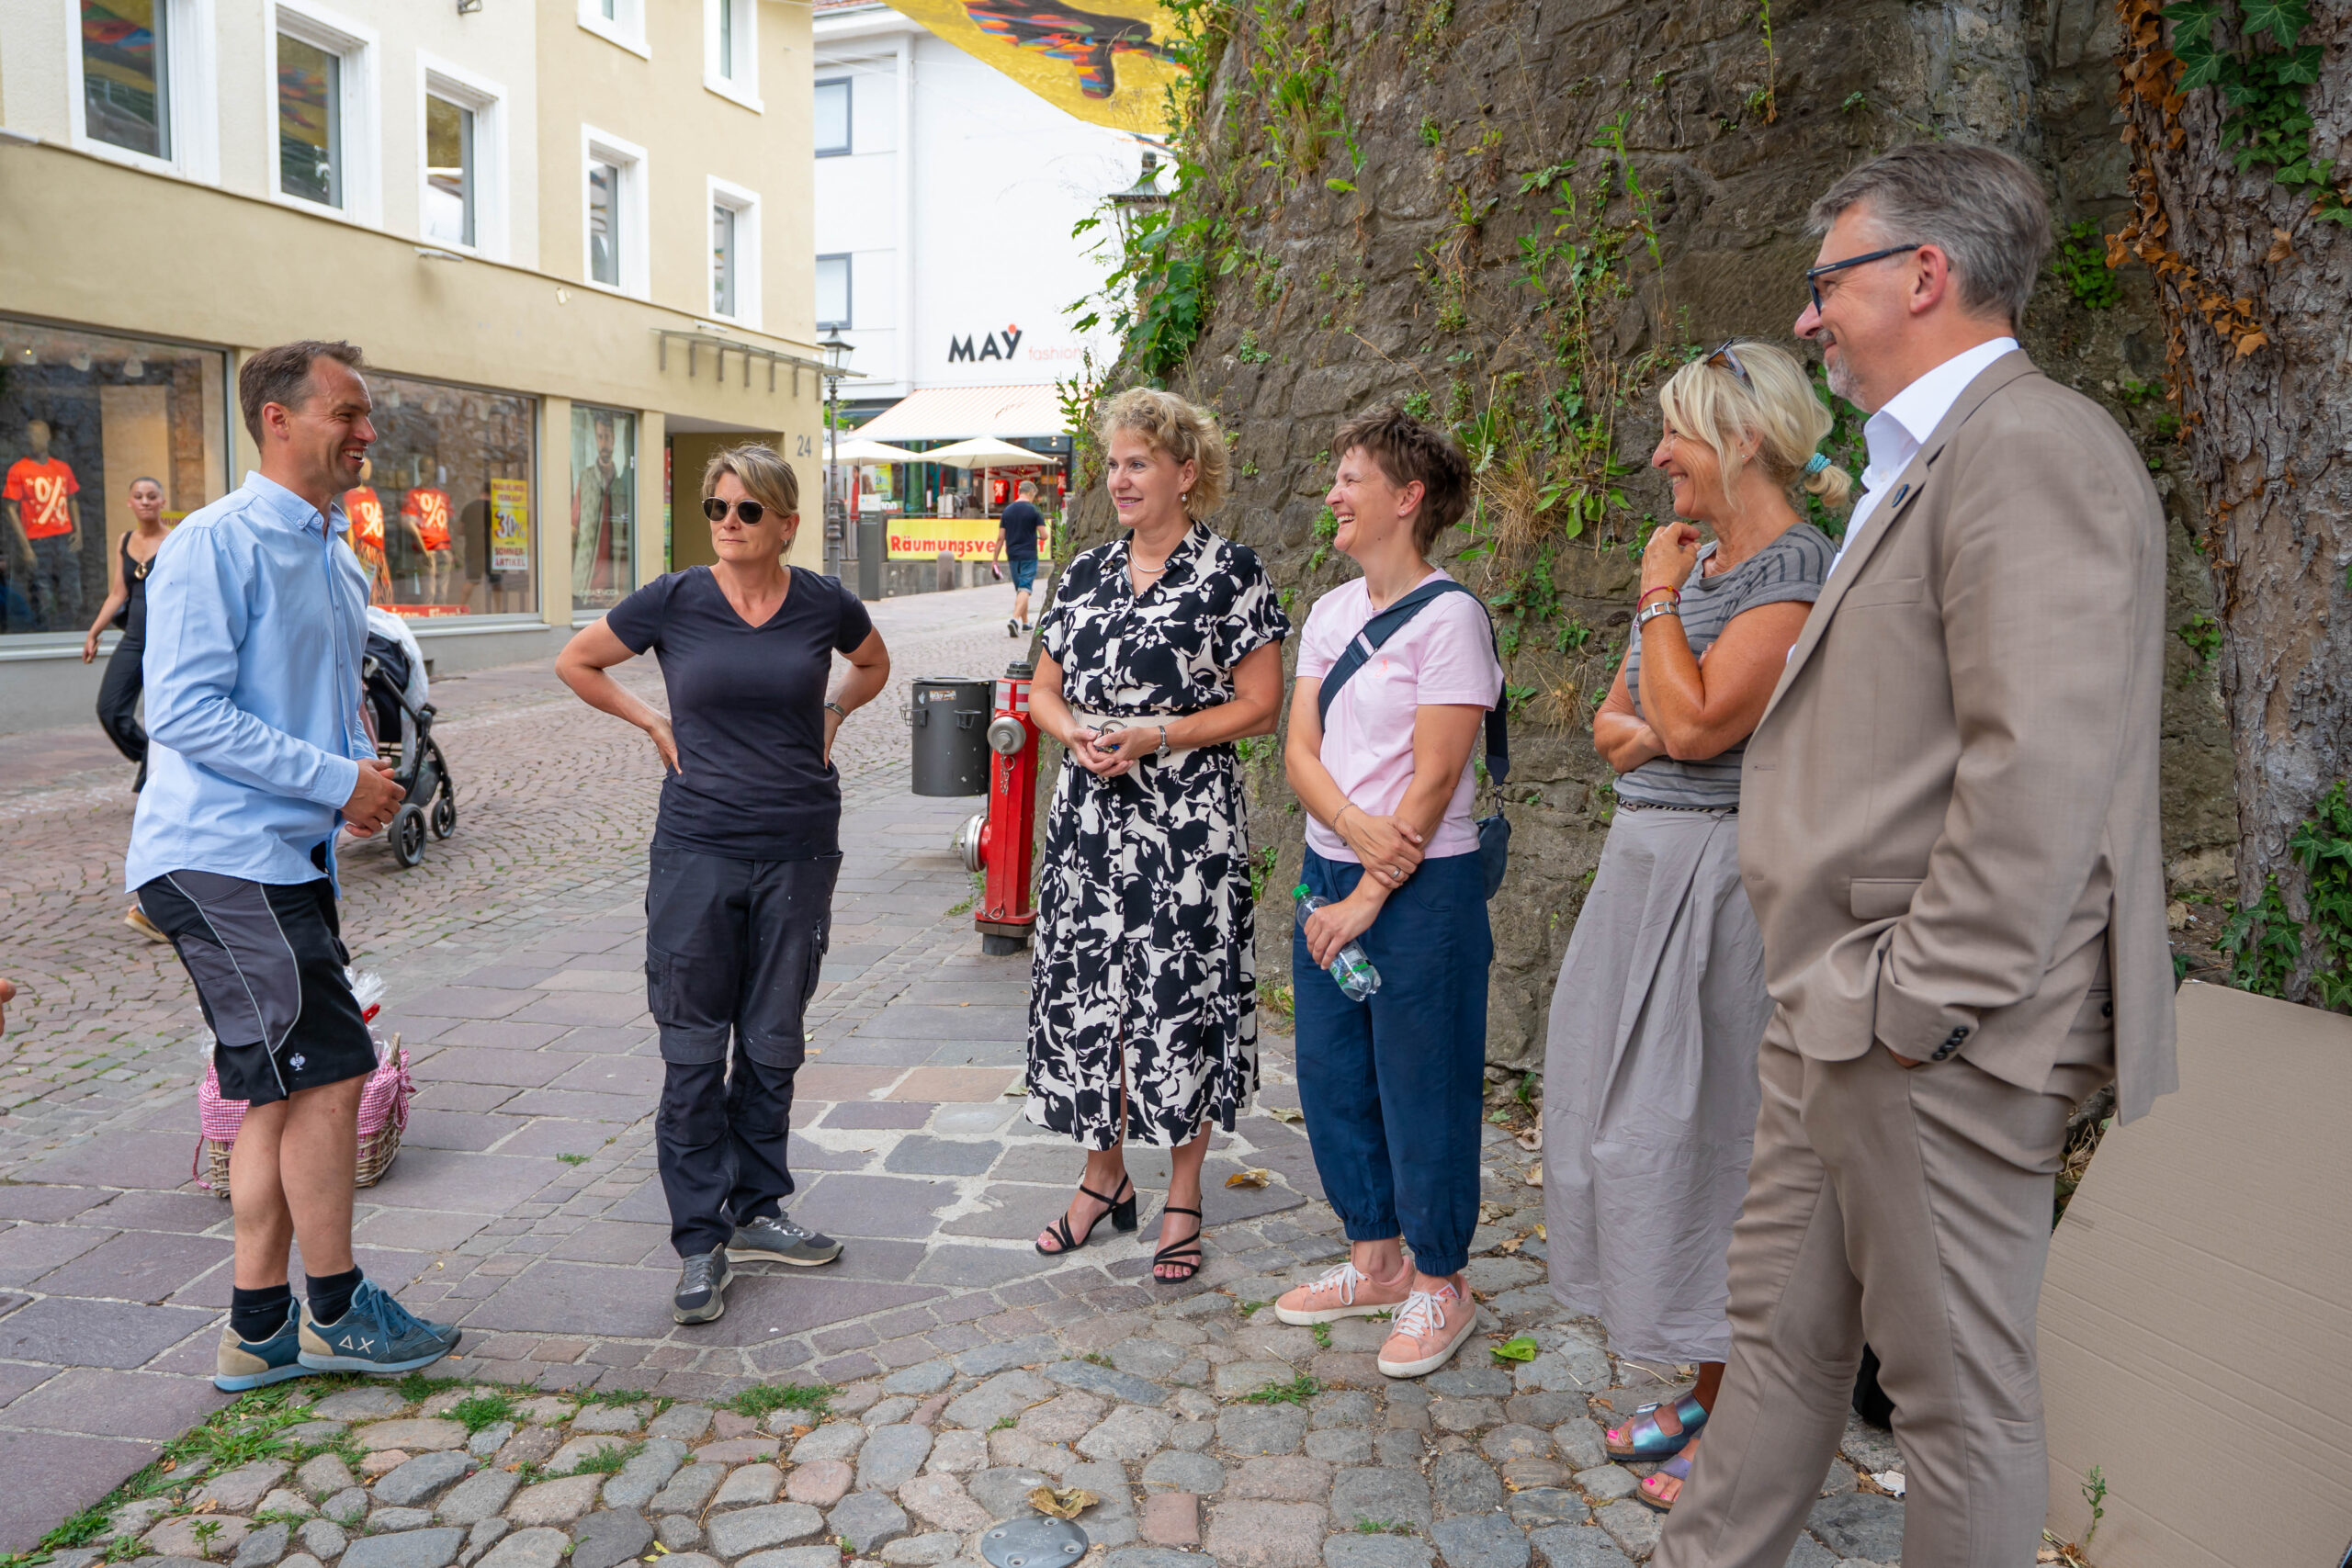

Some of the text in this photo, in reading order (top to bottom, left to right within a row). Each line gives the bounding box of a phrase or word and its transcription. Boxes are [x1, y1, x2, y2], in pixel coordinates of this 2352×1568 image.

[948, 324, 1082, 363] MAY fashion
[797, 434, 811, 458] 24
[494, 510, 526, 539] 30%
[890, 535, 1045, 558] Räumungsvef
[494, 558, 526, 567] ARTIKEL
